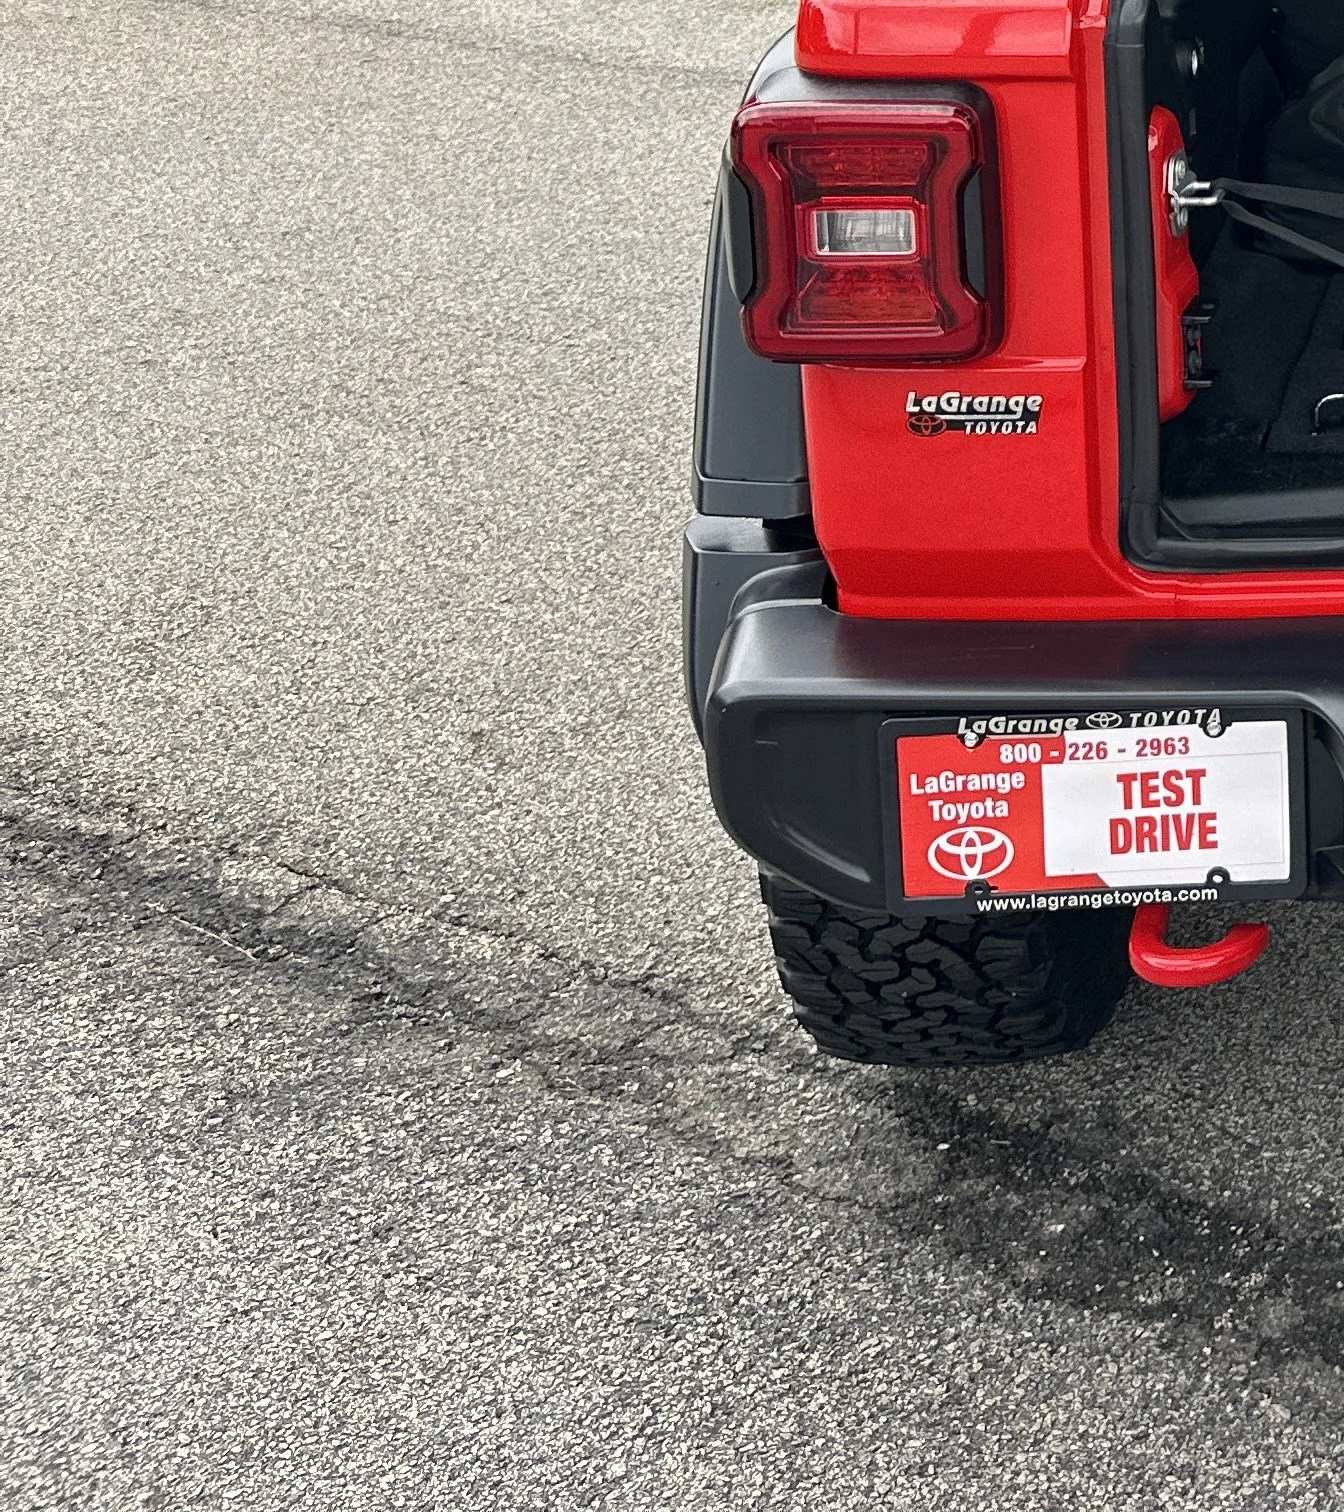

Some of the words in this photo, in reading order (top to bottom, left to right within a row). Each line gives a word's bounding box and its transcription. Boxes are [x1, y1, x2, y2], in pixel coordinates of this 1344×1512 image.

[906, 391, 1043, 419] LaGrange
[964, 420, 1038, 435] TOYOTA
[958, 716, 1079, 736] LaGrange
[1129, 708, 1222, 728] TOYOTA
[999, 743, 1042, 763] 800
[1068, 742, 1108, 762] 226
[1135, 738, 1191, 758] 2963
[910, 770, 1026, 796] LaGrange
[1116, 768, 1207, 811] TEST
[928, 797, 1010, 824] Toyota
[1109, 812, 1219, 855] DRIVE
[976, 886, 1218, 913] www.lagrangetoyota.com
